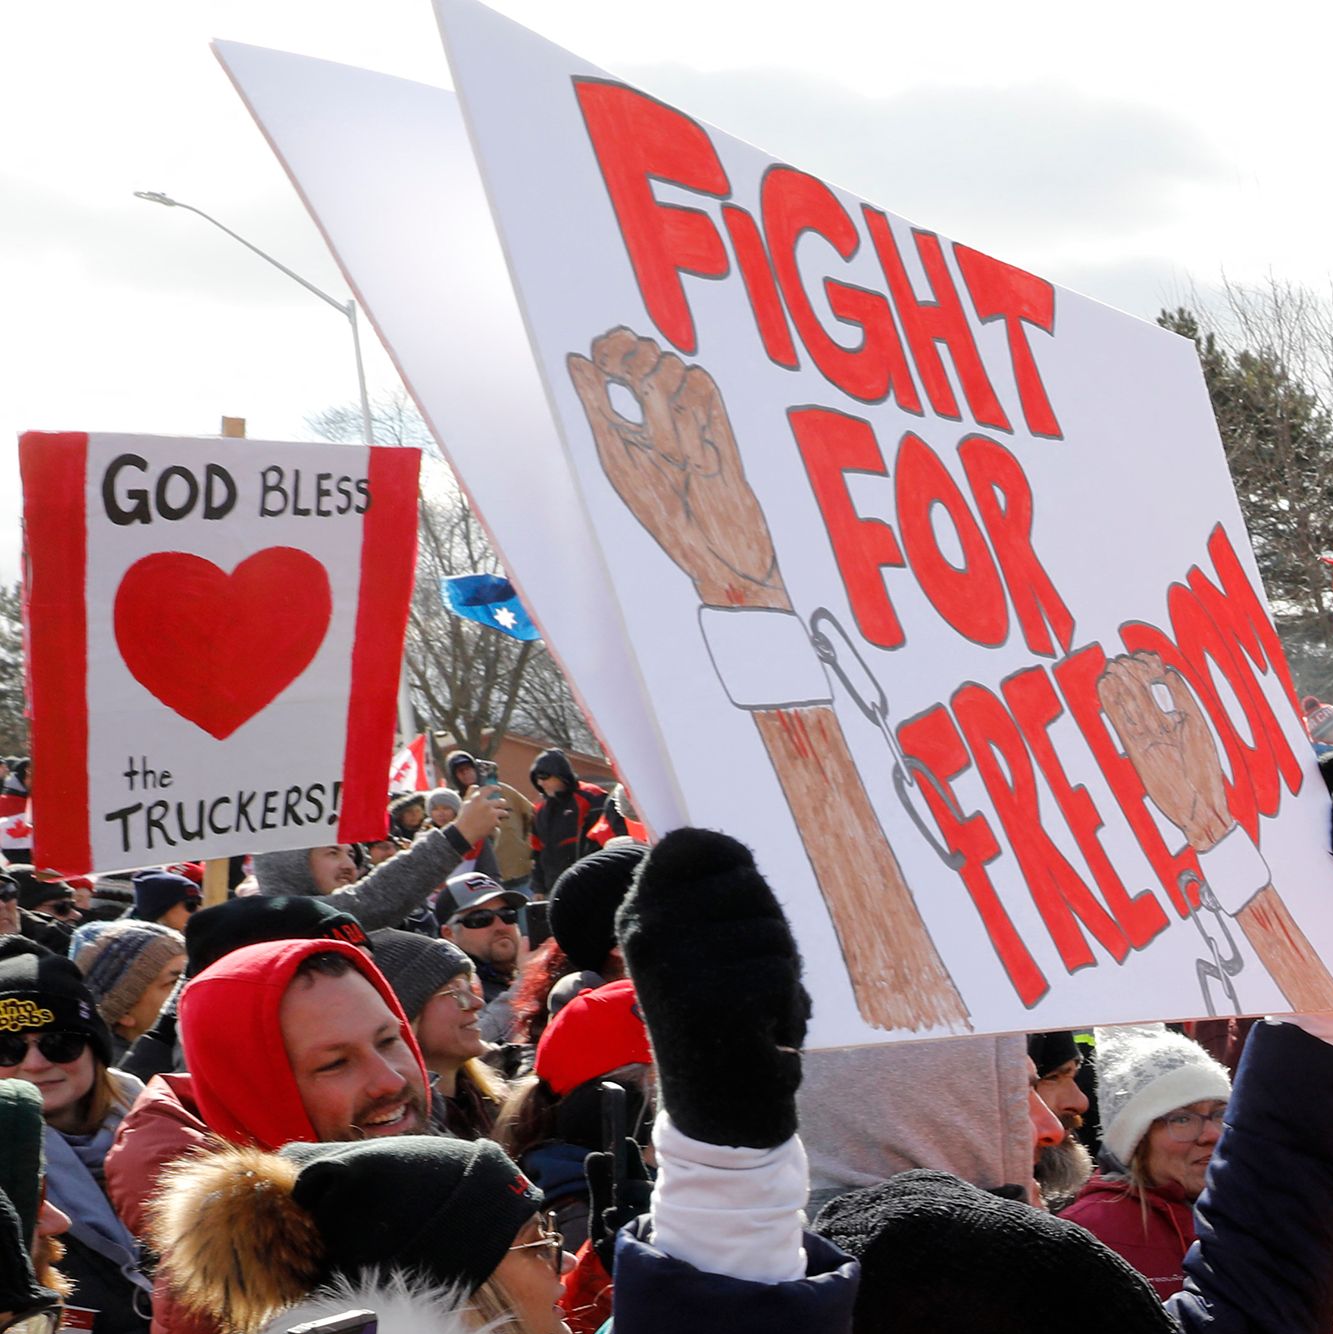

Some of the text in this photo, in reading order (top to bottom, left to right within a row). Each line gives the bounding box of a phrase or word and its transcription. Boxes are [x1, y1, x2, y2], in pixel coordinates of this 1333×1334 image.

[102, 453, 372, 526] GOD BLESS
[786, 404, 1076, 658] FOR
[123, 755, 174, 792] the
[105, 780, 345, 852] TRUCKERS!
